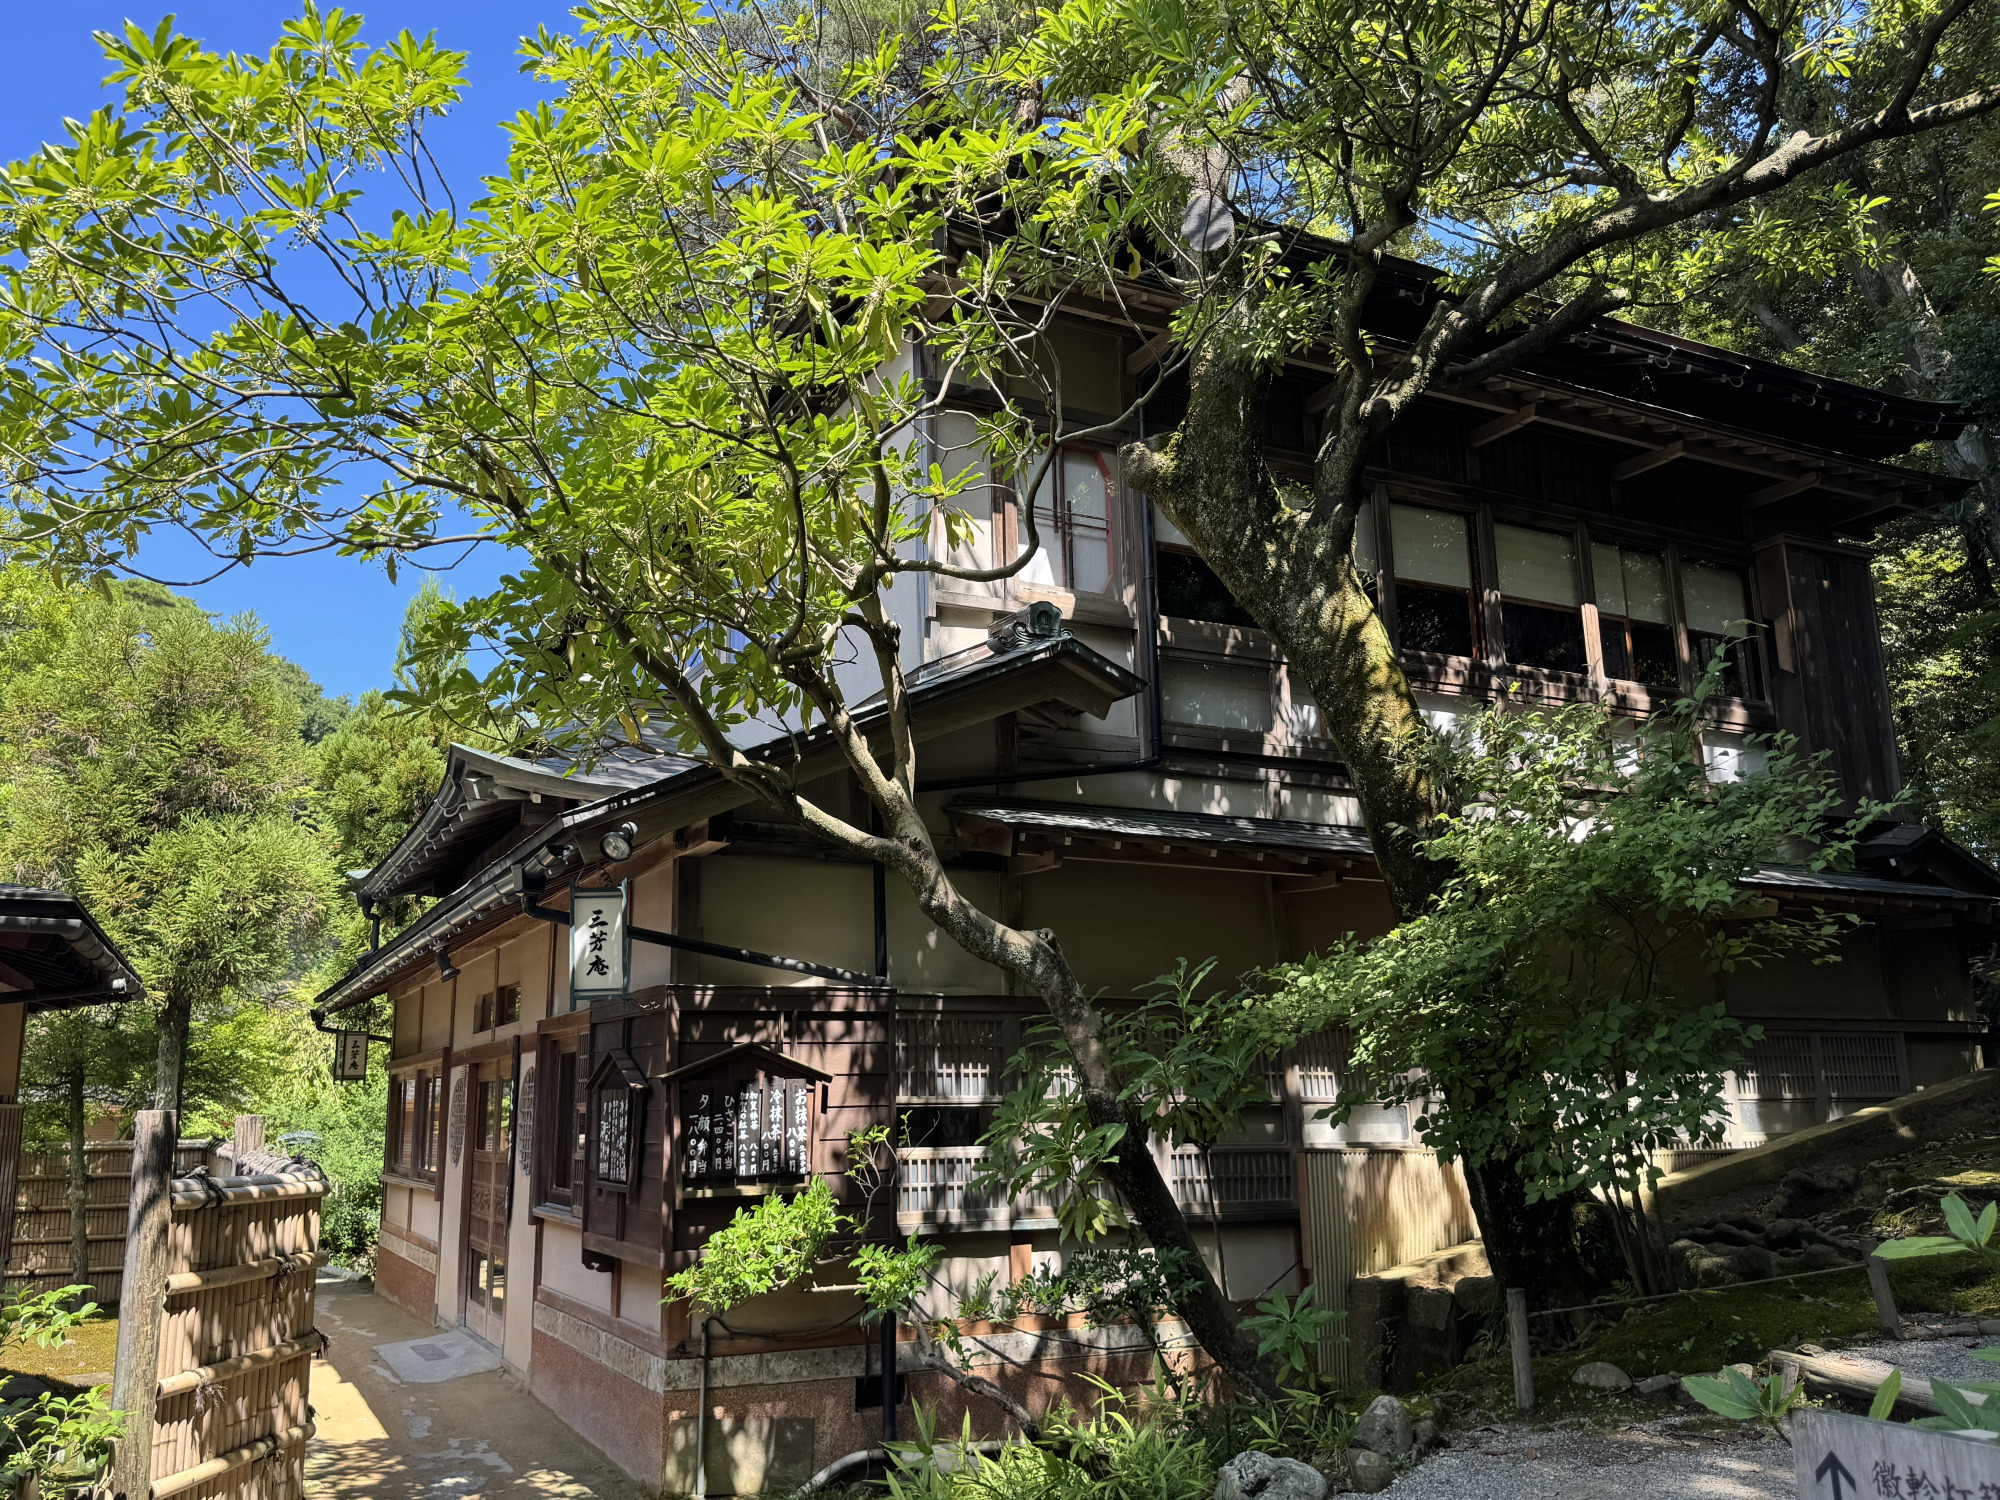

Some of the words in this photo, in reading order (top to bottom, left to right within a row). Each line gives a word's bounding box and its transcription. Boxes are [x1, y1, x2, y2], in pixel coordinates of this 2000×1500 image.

[586, 909, 609, 976] 三芳庵
[348, 1040, 361, 1070] 三芳庵
[697, 1094, 711, 1173] 夕顔弁当
[724, 1095, 735, 1170] ひさご弁当
[769, 1089, 784, 1142] 冷抹茶
[795, 1088, 808, 1142] お抹茶
